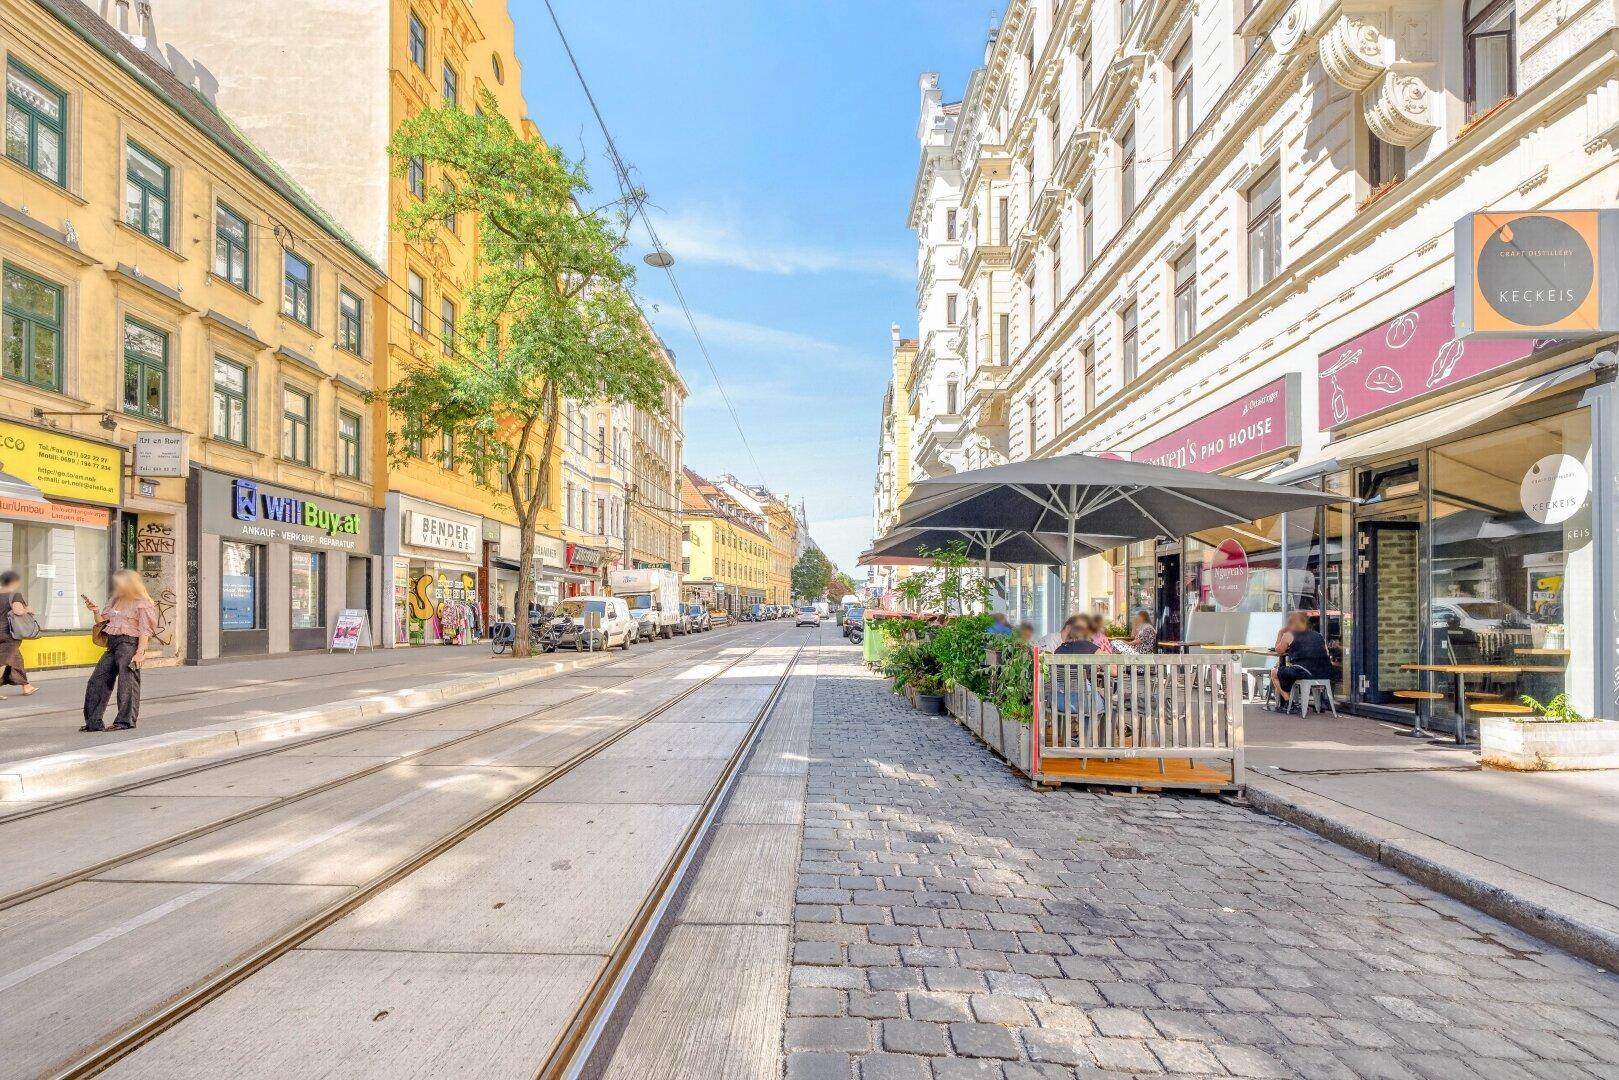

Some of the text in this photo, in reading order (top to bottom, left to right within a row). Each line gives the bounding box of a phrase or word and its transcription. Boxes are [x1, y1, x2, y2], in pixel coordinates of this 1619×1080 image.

[1499, 248, 1574, 257] CRAFT DISTILLERY
[1499, 289, 1575, 302] KECKEIS
[1201, 438, 1224, 460] PHO
[1228, 416, 1273, 449] HOUSE
[1532, 496, 1577, 512] KECKEIS
[241, 525, 356, 549] ANKAUF VERKAUF REPARATUR
[422, 517, 469, 541] BENDER
[422, 534, 470, 550] VINTAGE
